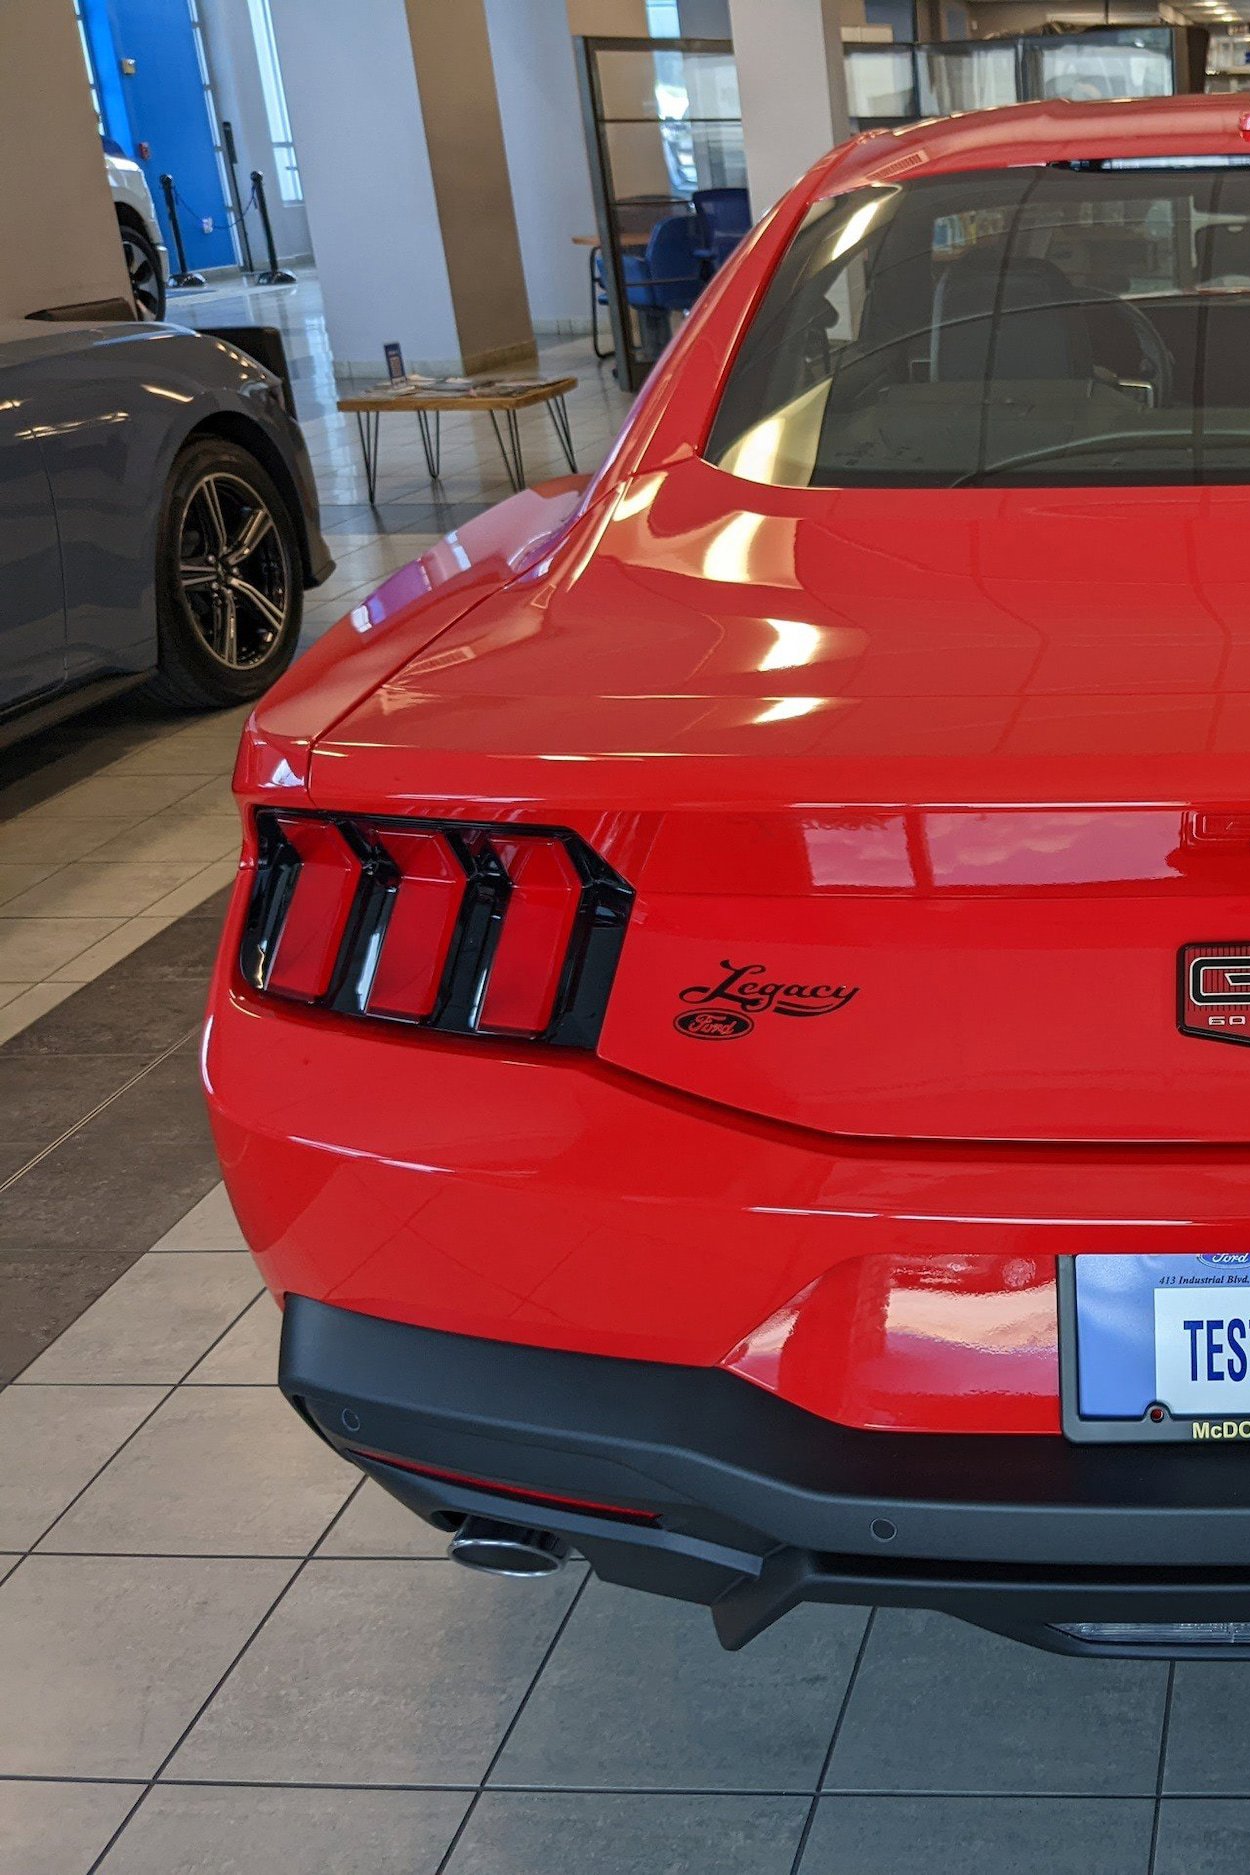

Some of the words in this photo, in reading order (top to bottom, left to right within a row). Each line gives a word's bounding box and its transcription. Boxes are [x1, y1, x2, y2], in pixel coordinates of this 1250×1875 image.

[678, 959, 861, 1018] Legacy
[688, 1014, 739, 1035] Ford
[1208, 1015, 1247, 1026] 60
[1159, 1276, 1176, 1285] 413
[1178, 1275, 1224, 1285] Industrial
[1227, 1275, 1250, 1284] Blvd.
